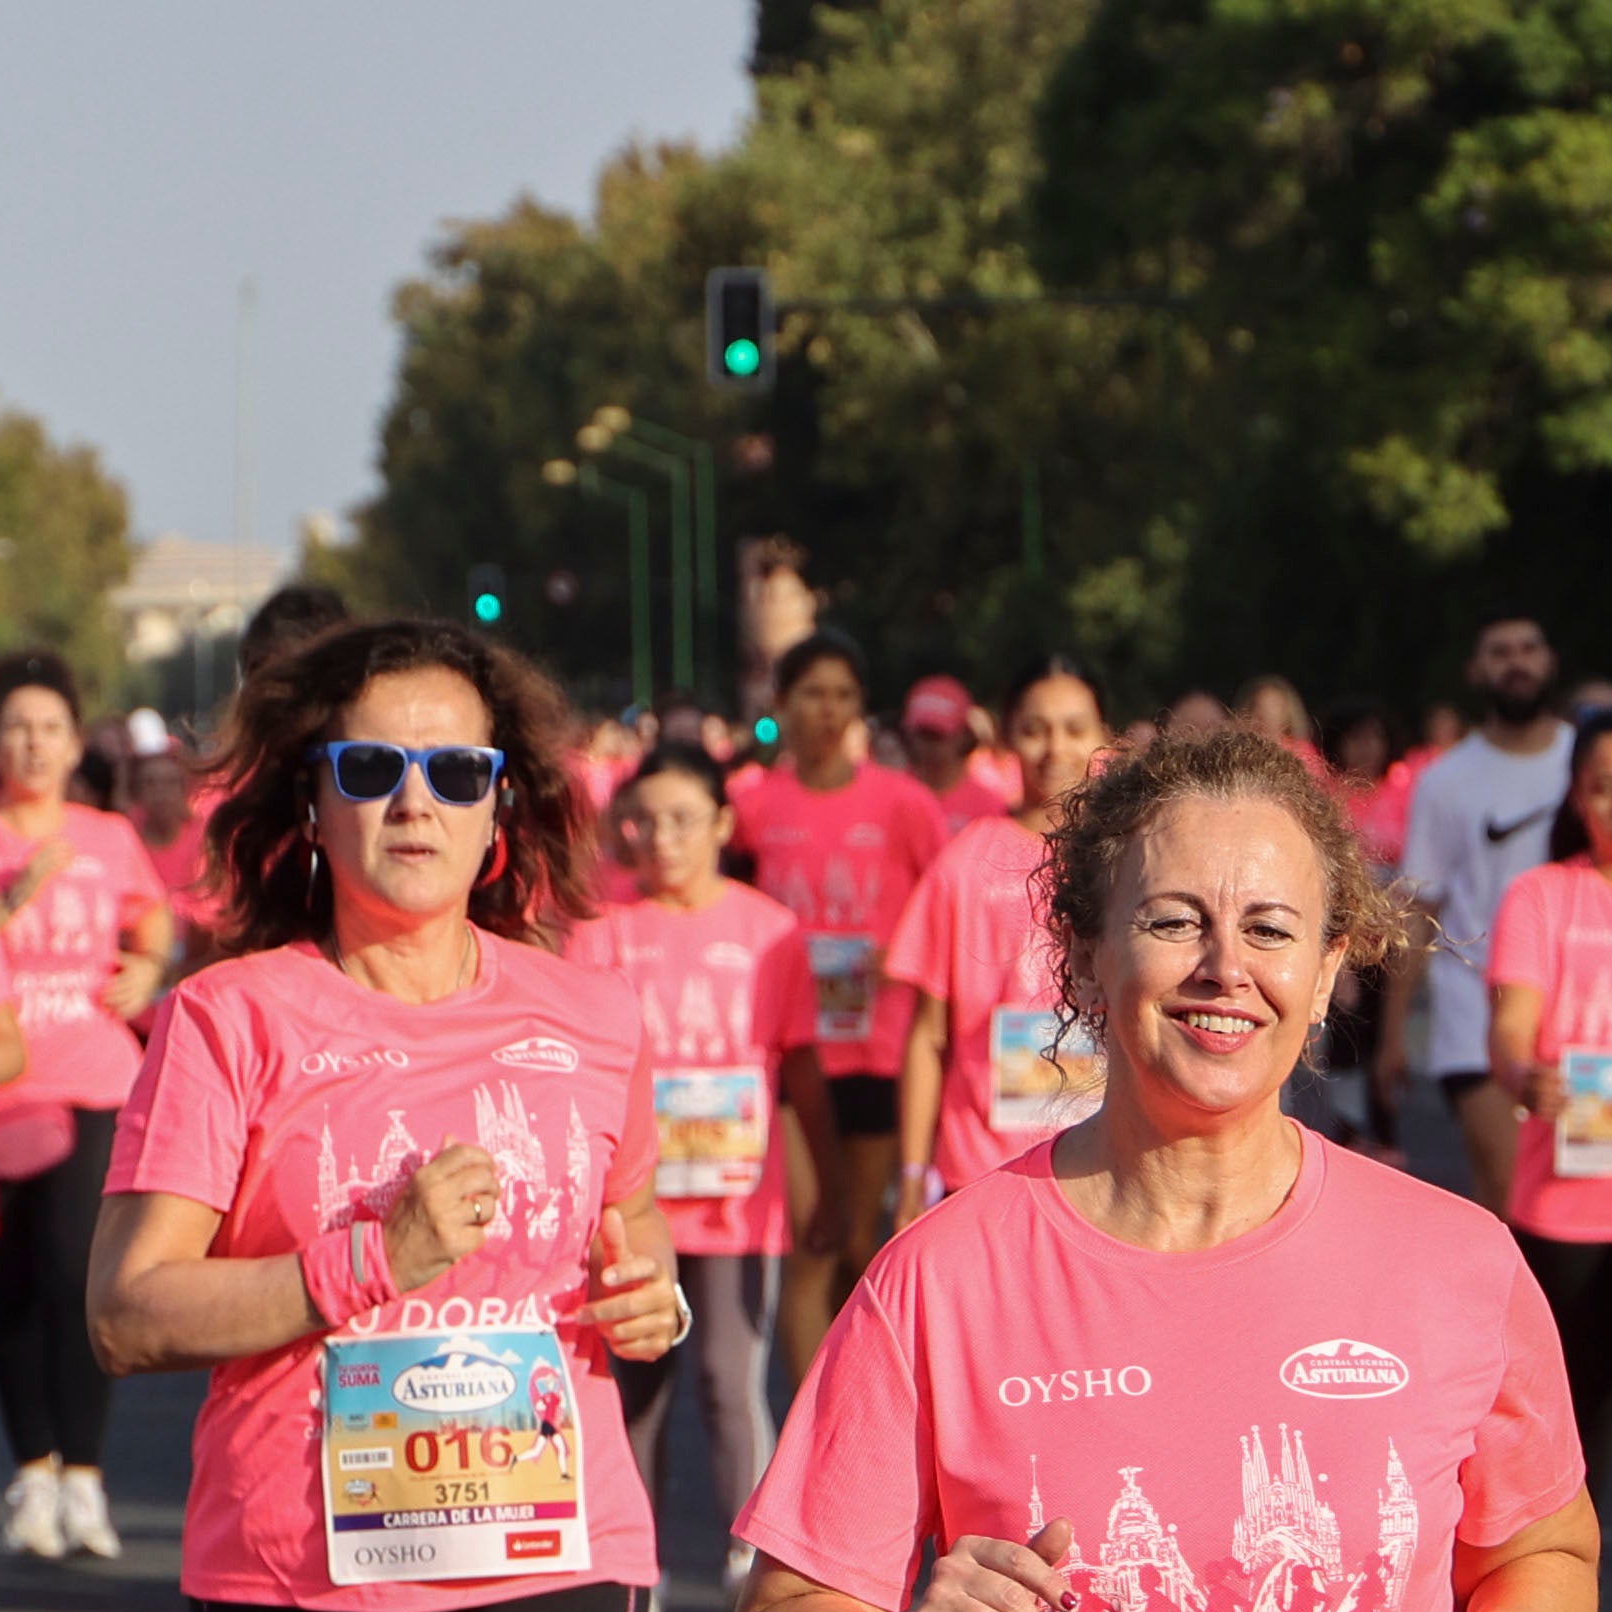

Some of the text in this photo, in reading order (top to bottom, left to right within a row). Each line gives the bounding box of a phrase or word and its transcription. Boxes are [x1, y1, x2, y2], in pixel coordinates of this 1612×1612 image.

[338, 1373, 381, 1389] SUMA
[1291, 1361, 1401, 1385] ASTURIANA
[403, 1376, 509, 1401] ASTURIANA
[998, 1365, 1153, 1408] OYSHO
[404, 1426, 513, 1473] 016
[434, 1481, 490, 1504] 3751
[383, 1504, 536, 1529] CARRERA DE LA MUJER
[354, 1544, 437, 1566] OYSHO
